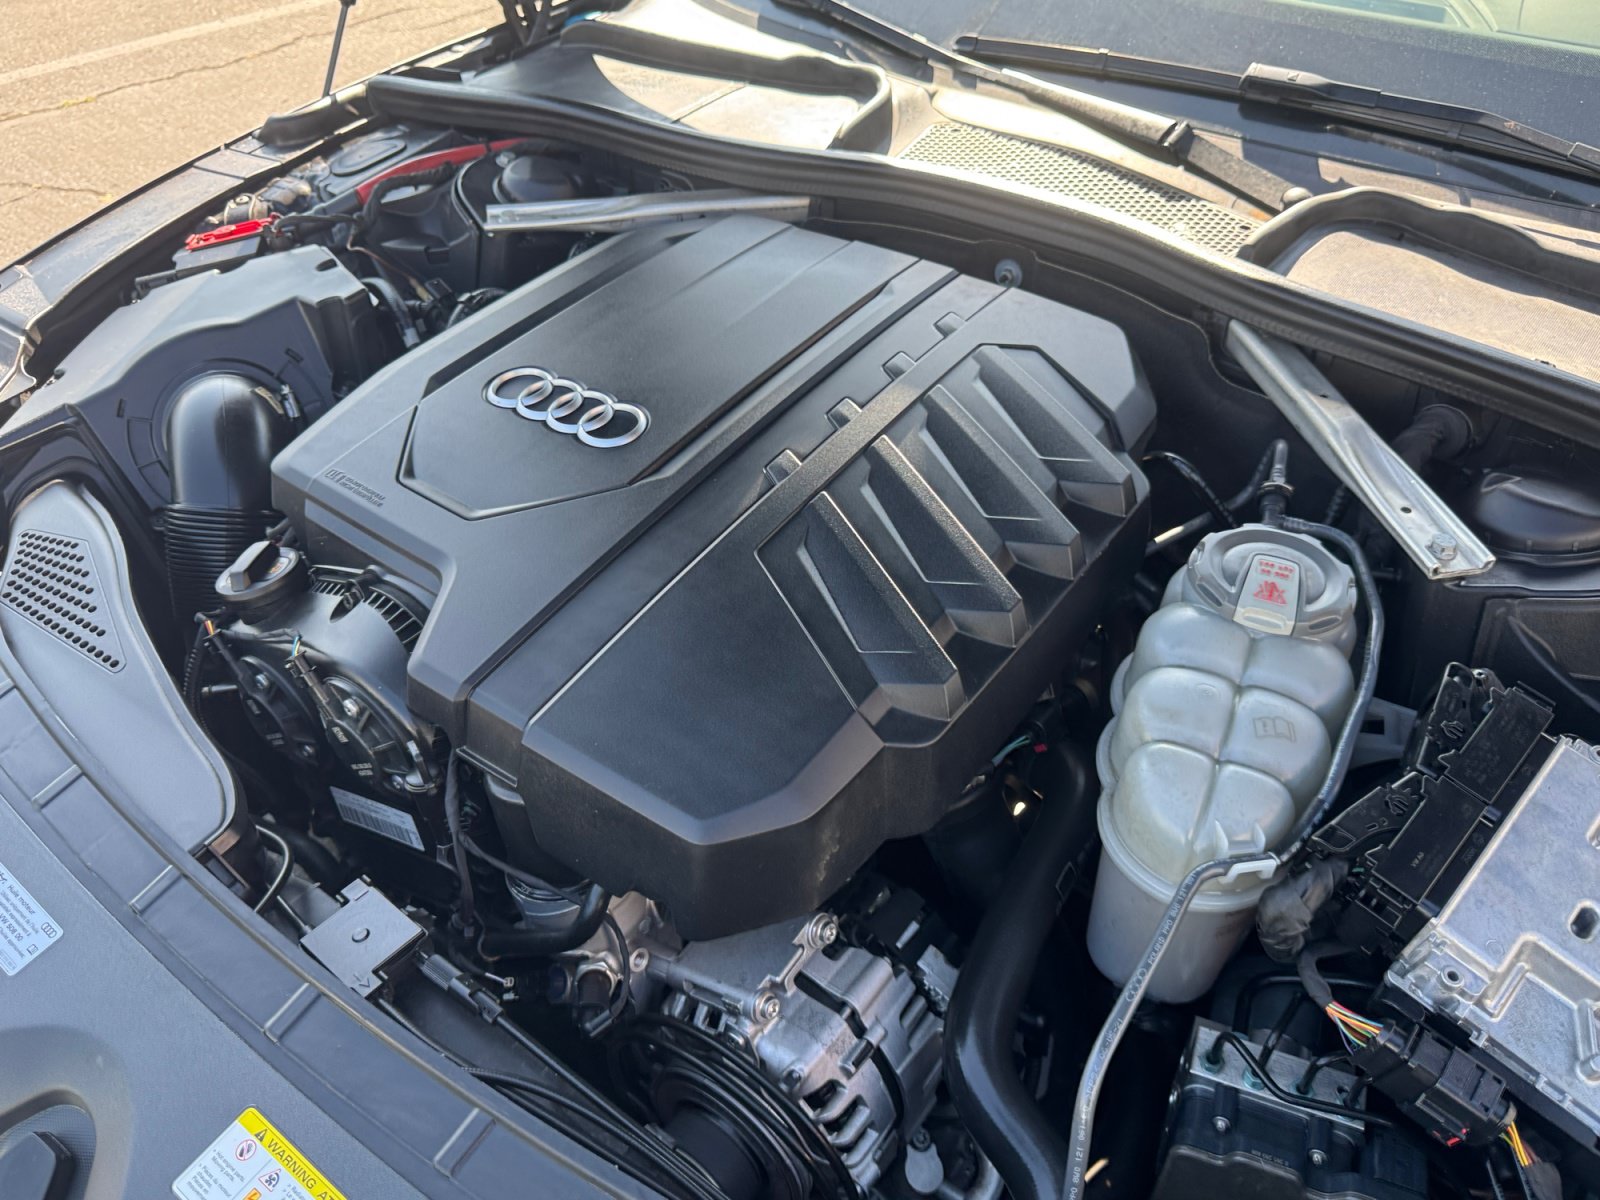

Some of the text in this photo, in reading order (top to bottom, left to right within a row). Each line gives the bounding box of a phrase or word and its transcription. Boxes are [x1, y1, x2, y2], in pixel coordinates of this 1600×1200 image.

[18, 897, 36, 914] moteur
[1075, 1147, 1084, 1161] 121
[268, 1138, 317, 1189] WARNING
